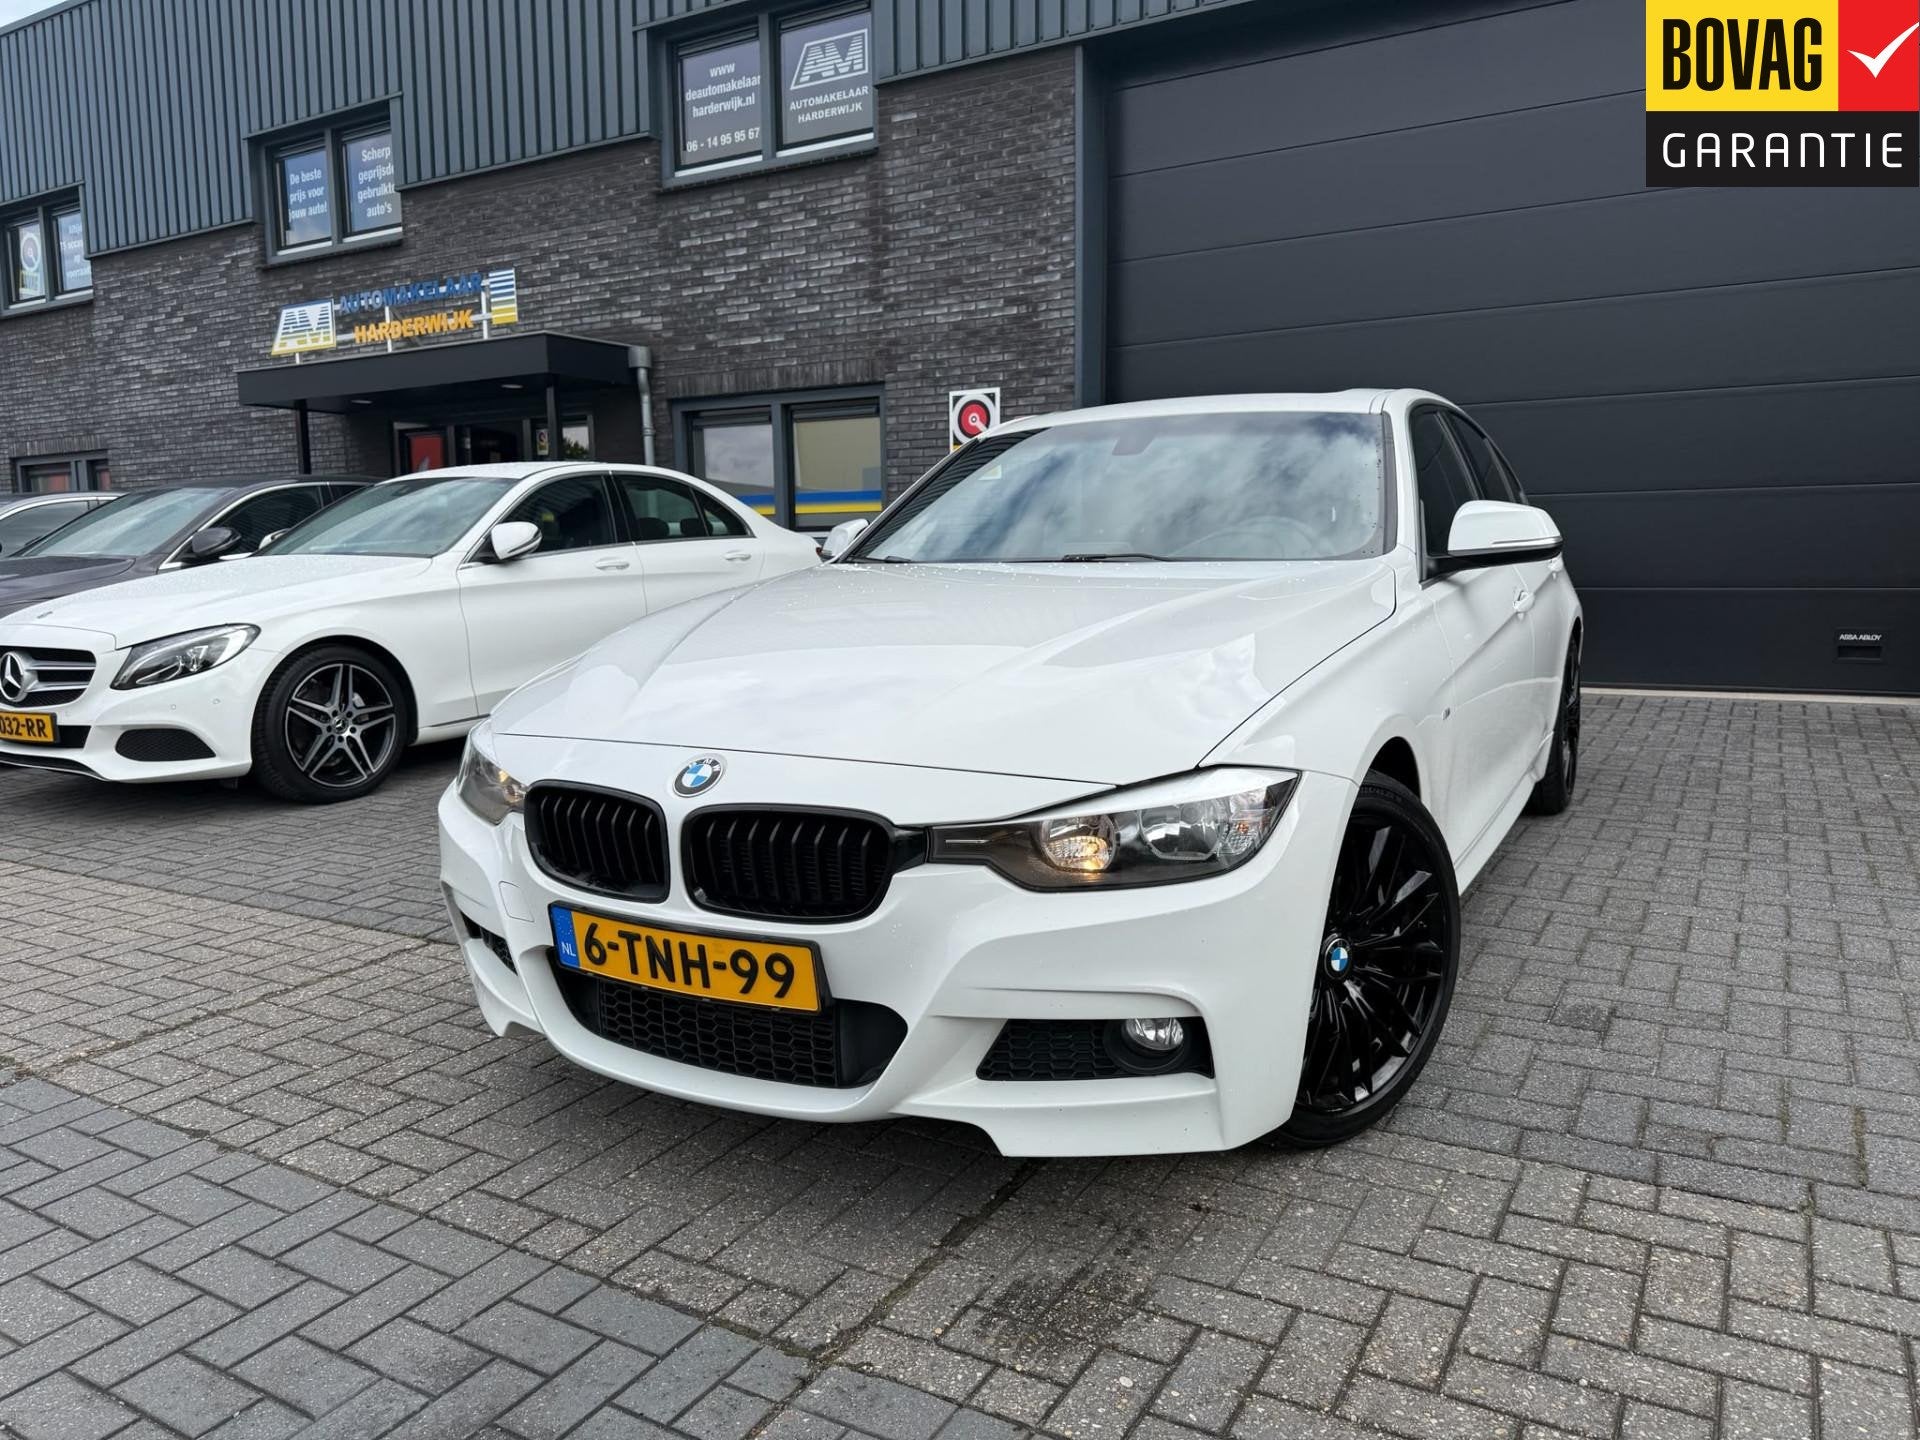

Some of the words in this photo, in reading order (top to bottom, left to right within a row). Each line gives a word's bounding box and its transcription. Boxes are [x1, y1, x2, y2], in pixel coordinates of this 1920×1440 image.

[709, 63, 735, 77] www
[686, 75, 761, 101] deautomakelaar
[790, 85, 869, 111] AUTOMAKELAAR
[692, 92, 755, 118] harderwijk.nl
[798, 102, 863, 123] HARDERWIJK
[686, 140, 698, 152] 06
[707, 136, 718, 148] 14
[720, 133, 732, 146] 95
[734, 129, 746, 142] 95
[748, 127, 760, 139] 67
[361, 147, 391, 162] Scherp
[290, 173, 300, 185] De
[301, 168, 322, 183] beste
[358, 163, 394, 184] geprijsd
[290, 188, 306, 205] prijs
[308, 186, 325, 199] voor
[288, 207, 306, 223] jouw
[308, 201, 328, 216] auto!
[366, 202, 393, 218] auto's
[338, 272, 484, 314] AUTOMAKELAAR
[354, 308, 474, 344] HARDERWIJK
[561, 942, 577, 957] NL
[584, 922, 795, 999] 6-TNH-99
